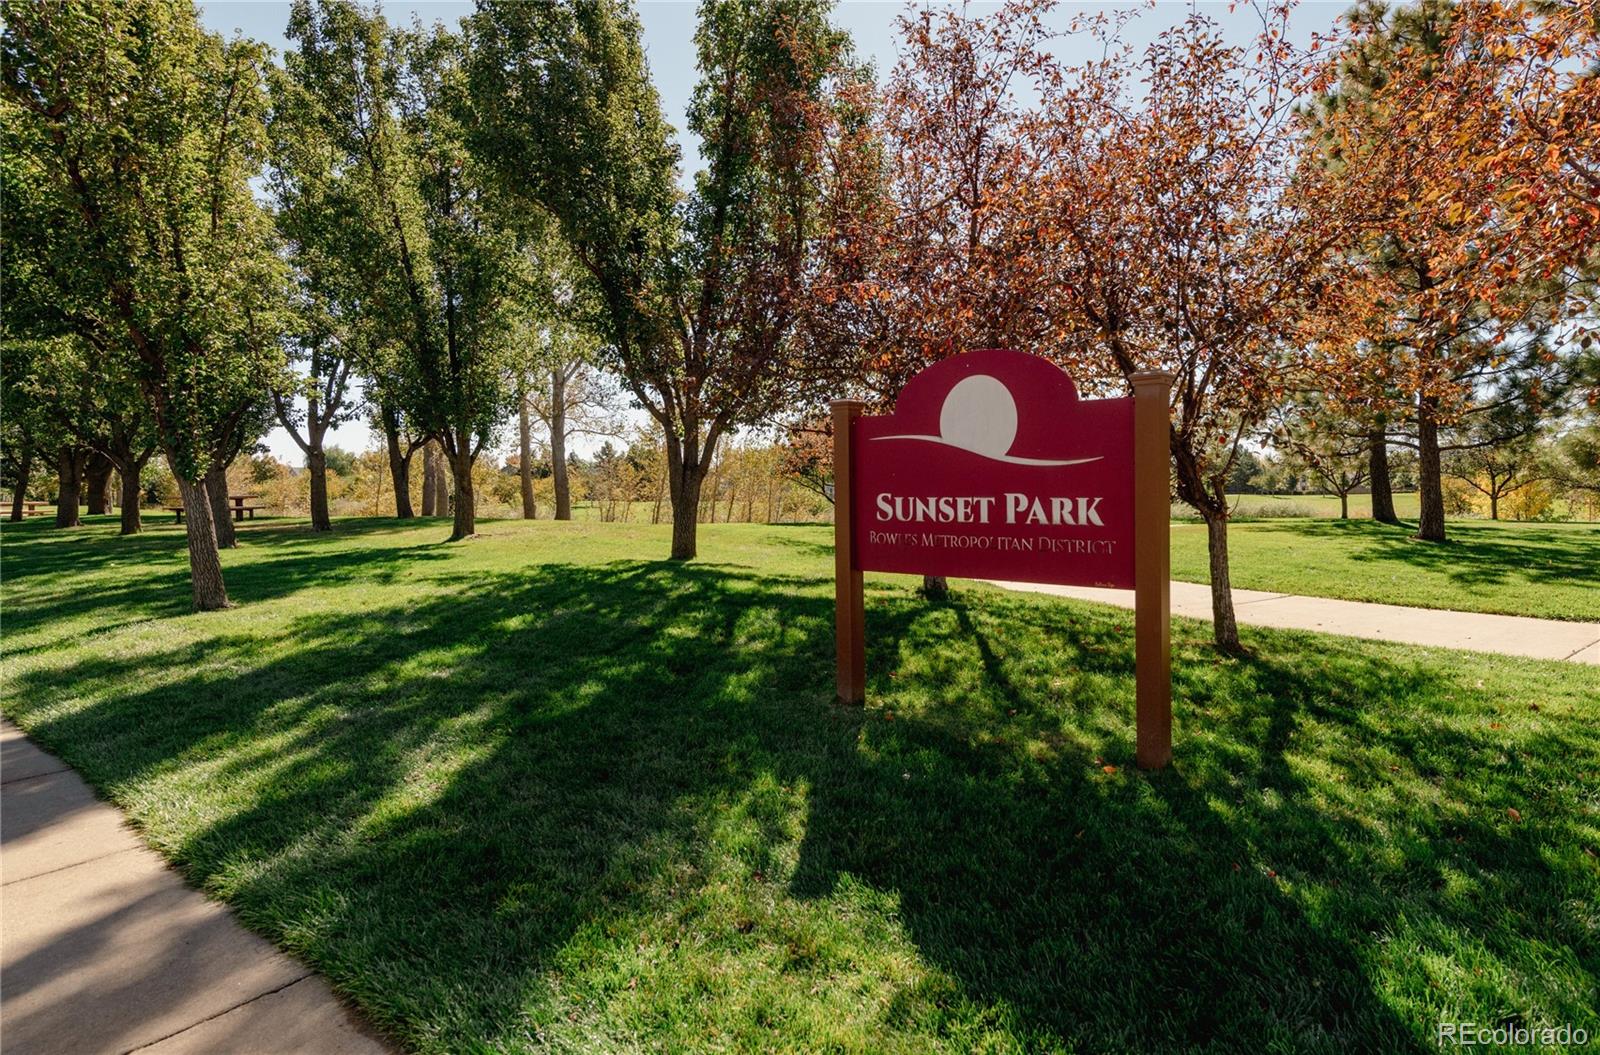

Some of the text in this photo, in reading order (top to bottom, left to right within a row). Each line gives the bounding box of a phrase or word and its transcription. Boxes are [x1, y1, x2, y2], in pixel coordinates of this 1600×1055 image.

[876, 492, 1105, 526] SUNSET PARK
[921, 532, 1033, 551] MTROPOITAN
[1039, 536, 1117, 554] DISTRICT
